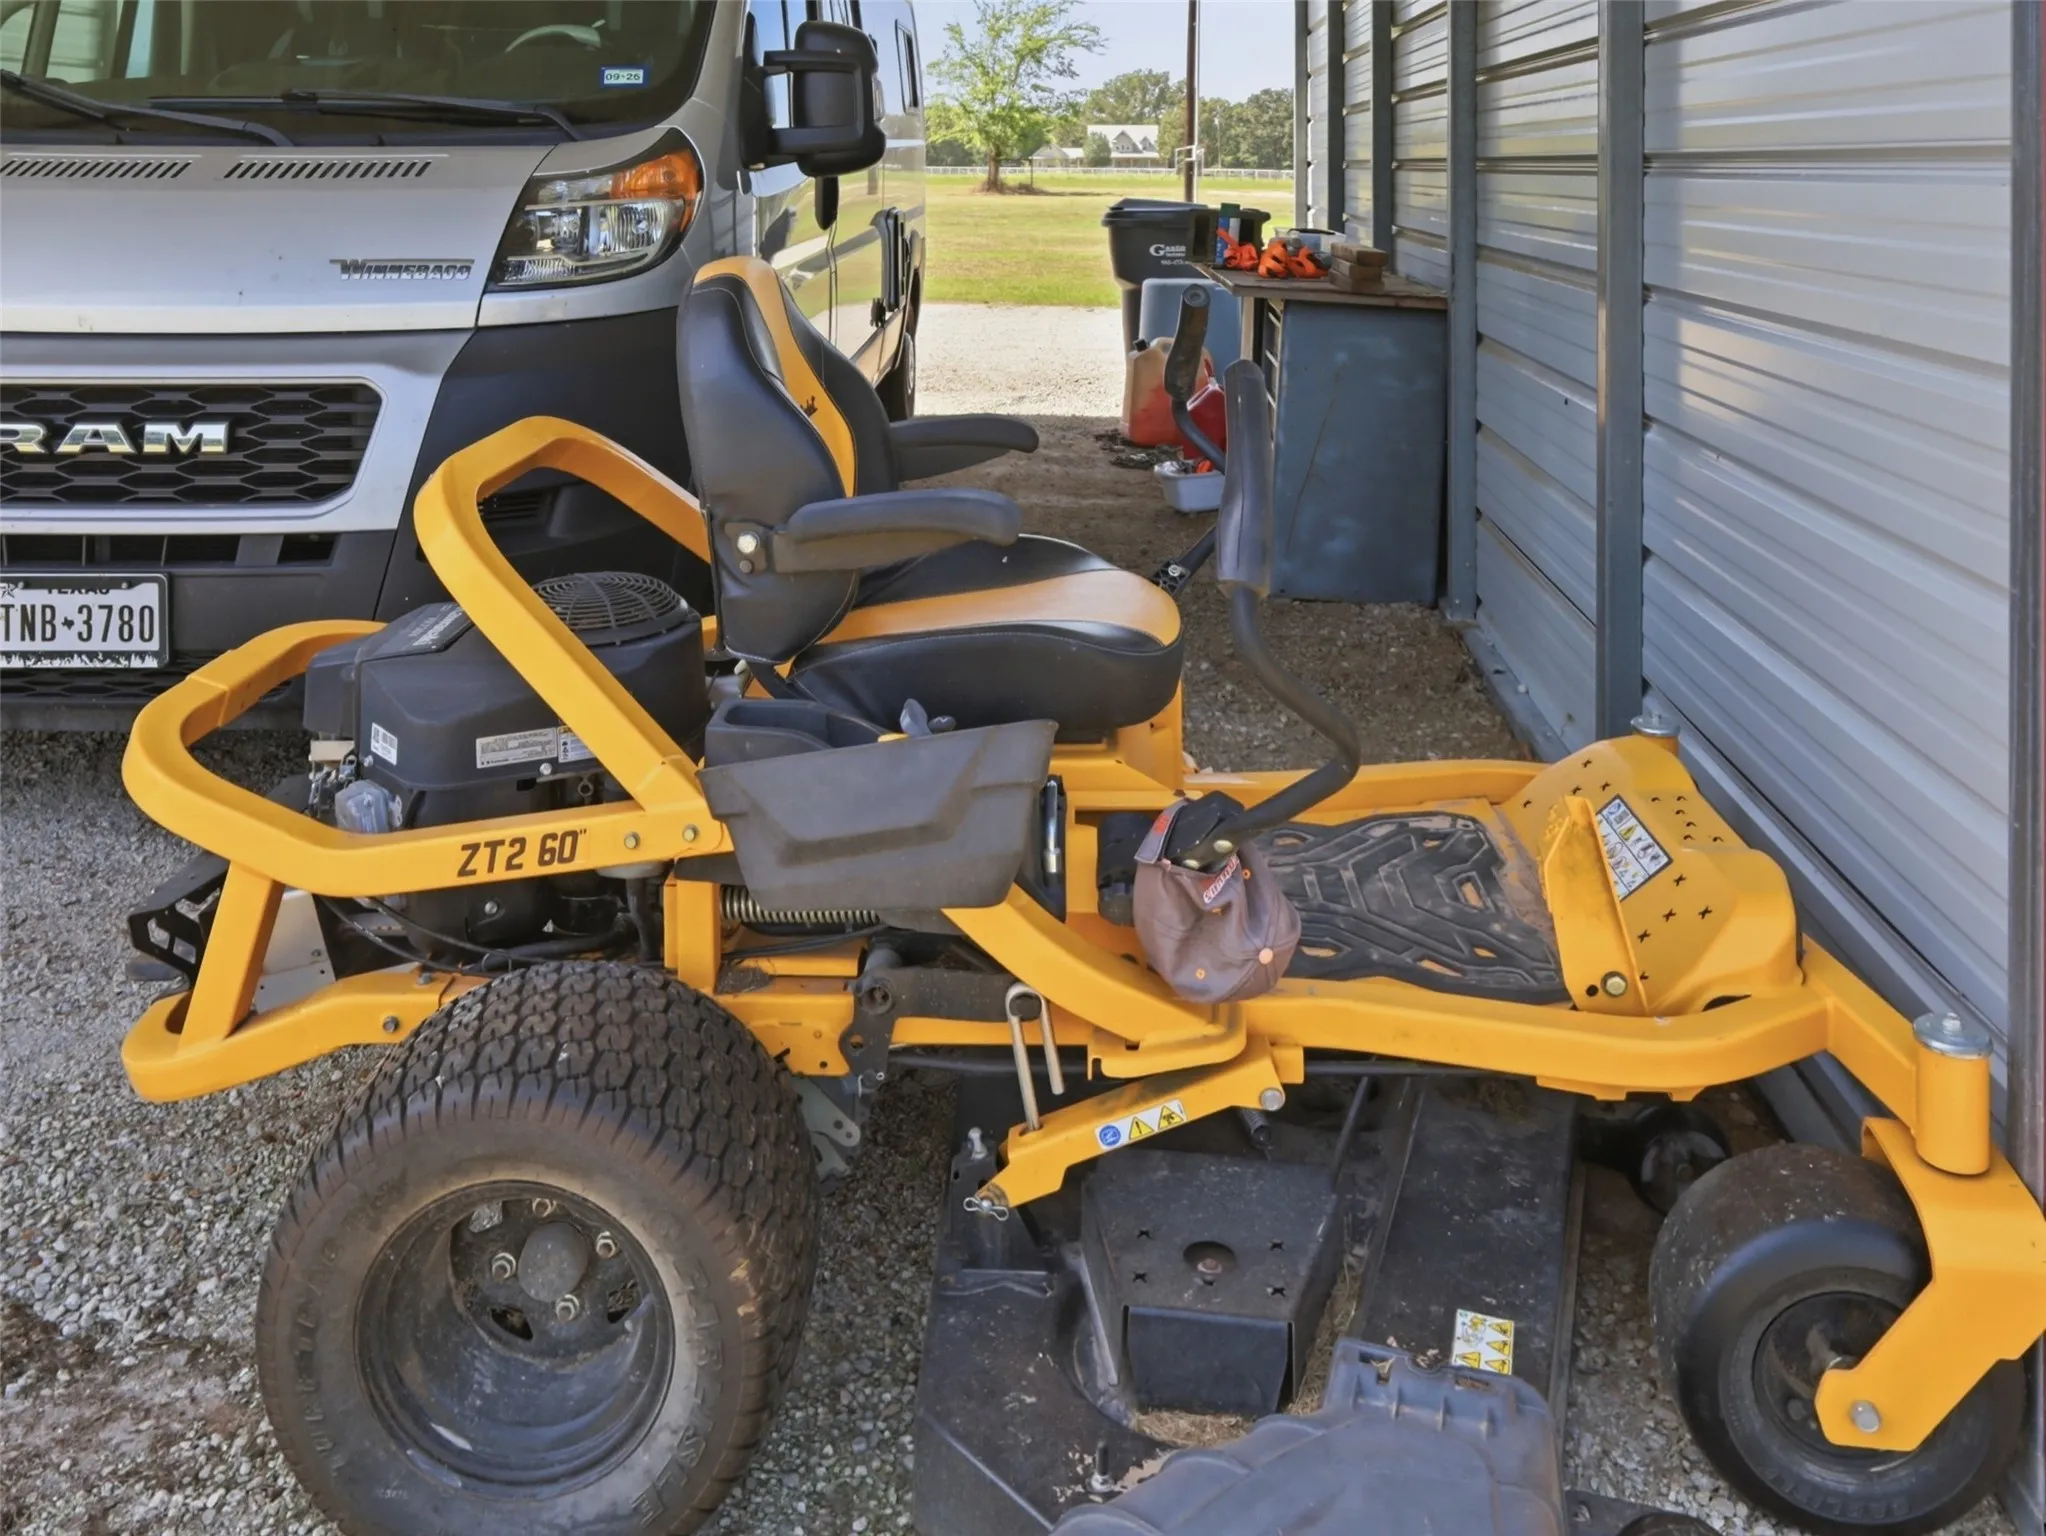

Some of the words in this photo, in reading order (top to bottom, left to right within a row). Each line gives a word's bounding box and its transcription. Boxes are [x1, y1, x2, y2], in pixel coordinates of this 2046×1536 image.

[338, 259, 473, 280] WINNEBAGO
[0, 422, 229, 454] RAM
[0, 603, 57, 642] TNB
[77, 604, 155, 642] 3780
[457, 836, 527, 878] ZT2
[537, 828, 588, 867] 60"
